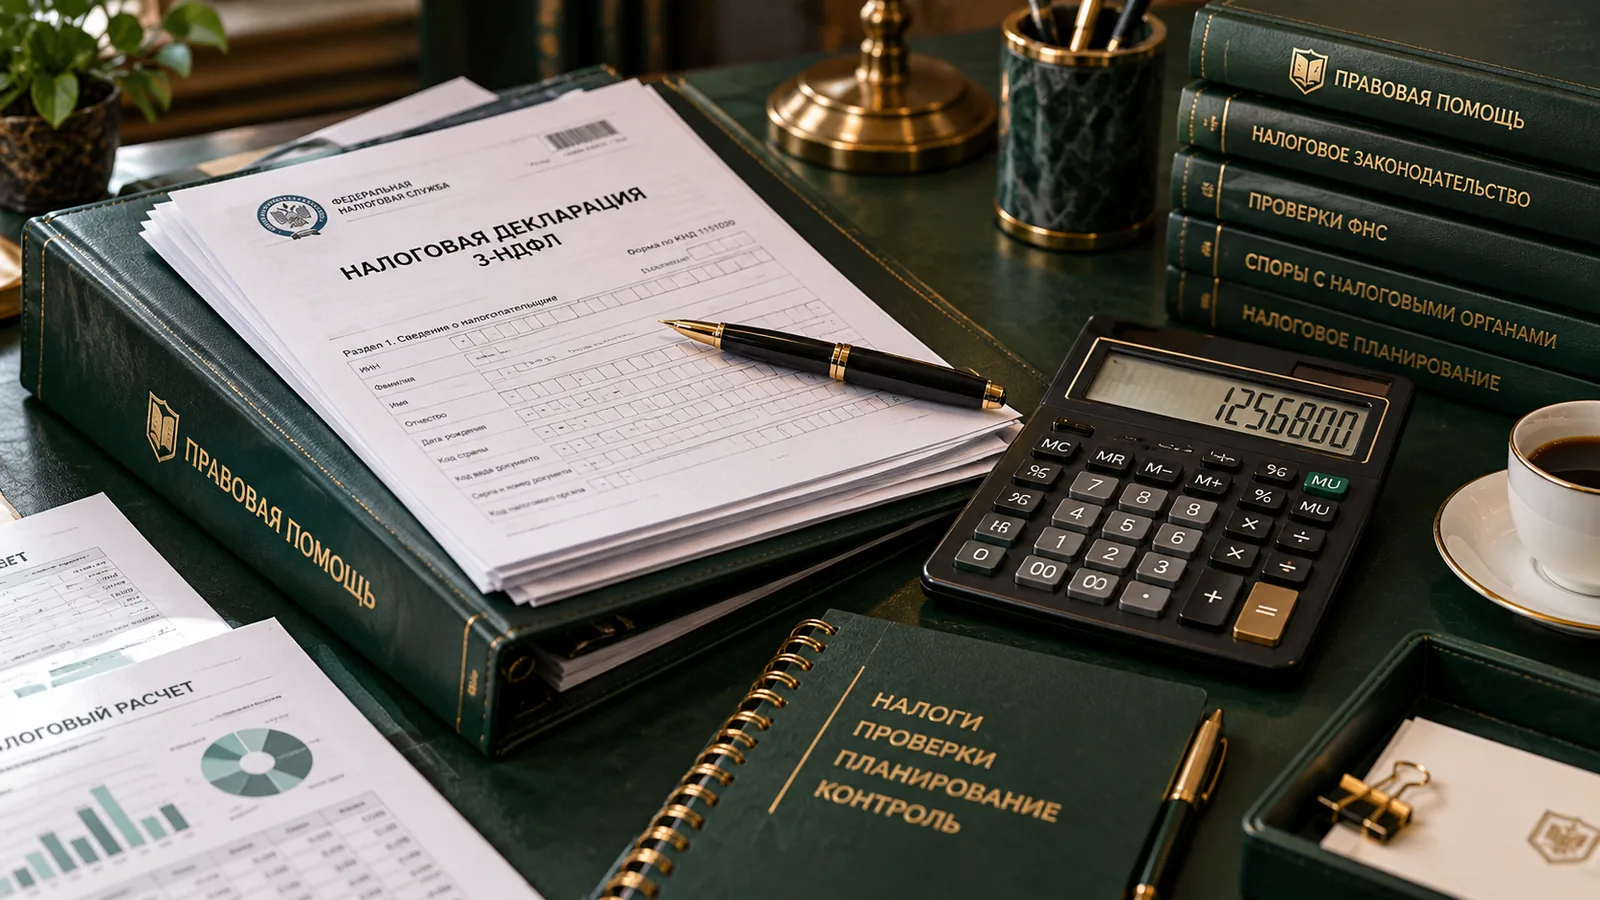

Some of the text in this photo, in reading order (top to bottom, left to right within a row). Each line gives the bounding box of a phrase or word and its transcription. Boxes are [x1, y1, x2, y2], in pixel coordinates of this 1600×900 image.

[1334, 69, 1525, 130] ПРАВОВАЯ ПОМОЩЬ
[1252, 125, 1531, 208] НАЛОГОВОЕ ЗАКОНОДАТЕЛЬСТВО
[405, 181, 450, 199] СЛУЖБА
[1248, 191, 1389, 242] ПРОВЕРКИ ФНС
[340, 187, 648, 281] НАЛОГОВАЯ ДЕКЛАРАЦИЯ
[661, 238, 674, 246] по
[674, 231, 698, 242] КНД
[472, 233, 563, 268] 3-НДФЛ
[1245, 252, 1557, 350] СПОРЫ С НАЛОГОВЫМИ ОРГАНАМИ
[397, 324, 450, 343] Сведения
[1243, 304, 1501, 392] НАЛОГОВОЕ ПЛАНИРОВАНИЕ
[405, 412, 447, 427] Отчество
[1215, 387, 1359, 448] 1256800
[421, 435, 443, 447] Дата
[1041, 438, 1071, 452] MC
[1095, 450, 1126, 465] MR
[1087, 478, 1104, 491] 7
[1194, 474, 1223, 488] M+
[1311, 475, 1341, 490] MU
[1136, 490, 1151, 504] 8
[1254, 488, 1272, 504] %
[1069, 506, 1085, 520] 4
[1186, 502, 1201, 516] 8
[1299, 500, 1330, 516] MU
[184, 436, 376, 610] ПРАВОВАЯ ПОМОЩЬ
[1120, 518, 1136, 532] 5
[1056, 534, 1067, 549] 1
[1170, 531, 1186, 545] 6
[972, 548, 990, 561] 0
[1102, 546, 1119, 561] 2
[1029, 561, 1057, 579] 00
[1153, 559, 1169, 574] 3
[0, 705, 112, 751] ЛОГОВЫЙ
[115, 680, 195, 714] РАСЧЕТ
[871, 691, 984, 732] НАЛОГИ
[852, 720, 997, 770] ПРОВЕРКИ
[833, 749, 1062, 823] ПЛАНИРОВАНИЕ
[813, 779, 962, 834] КОНТРОЛЬ
